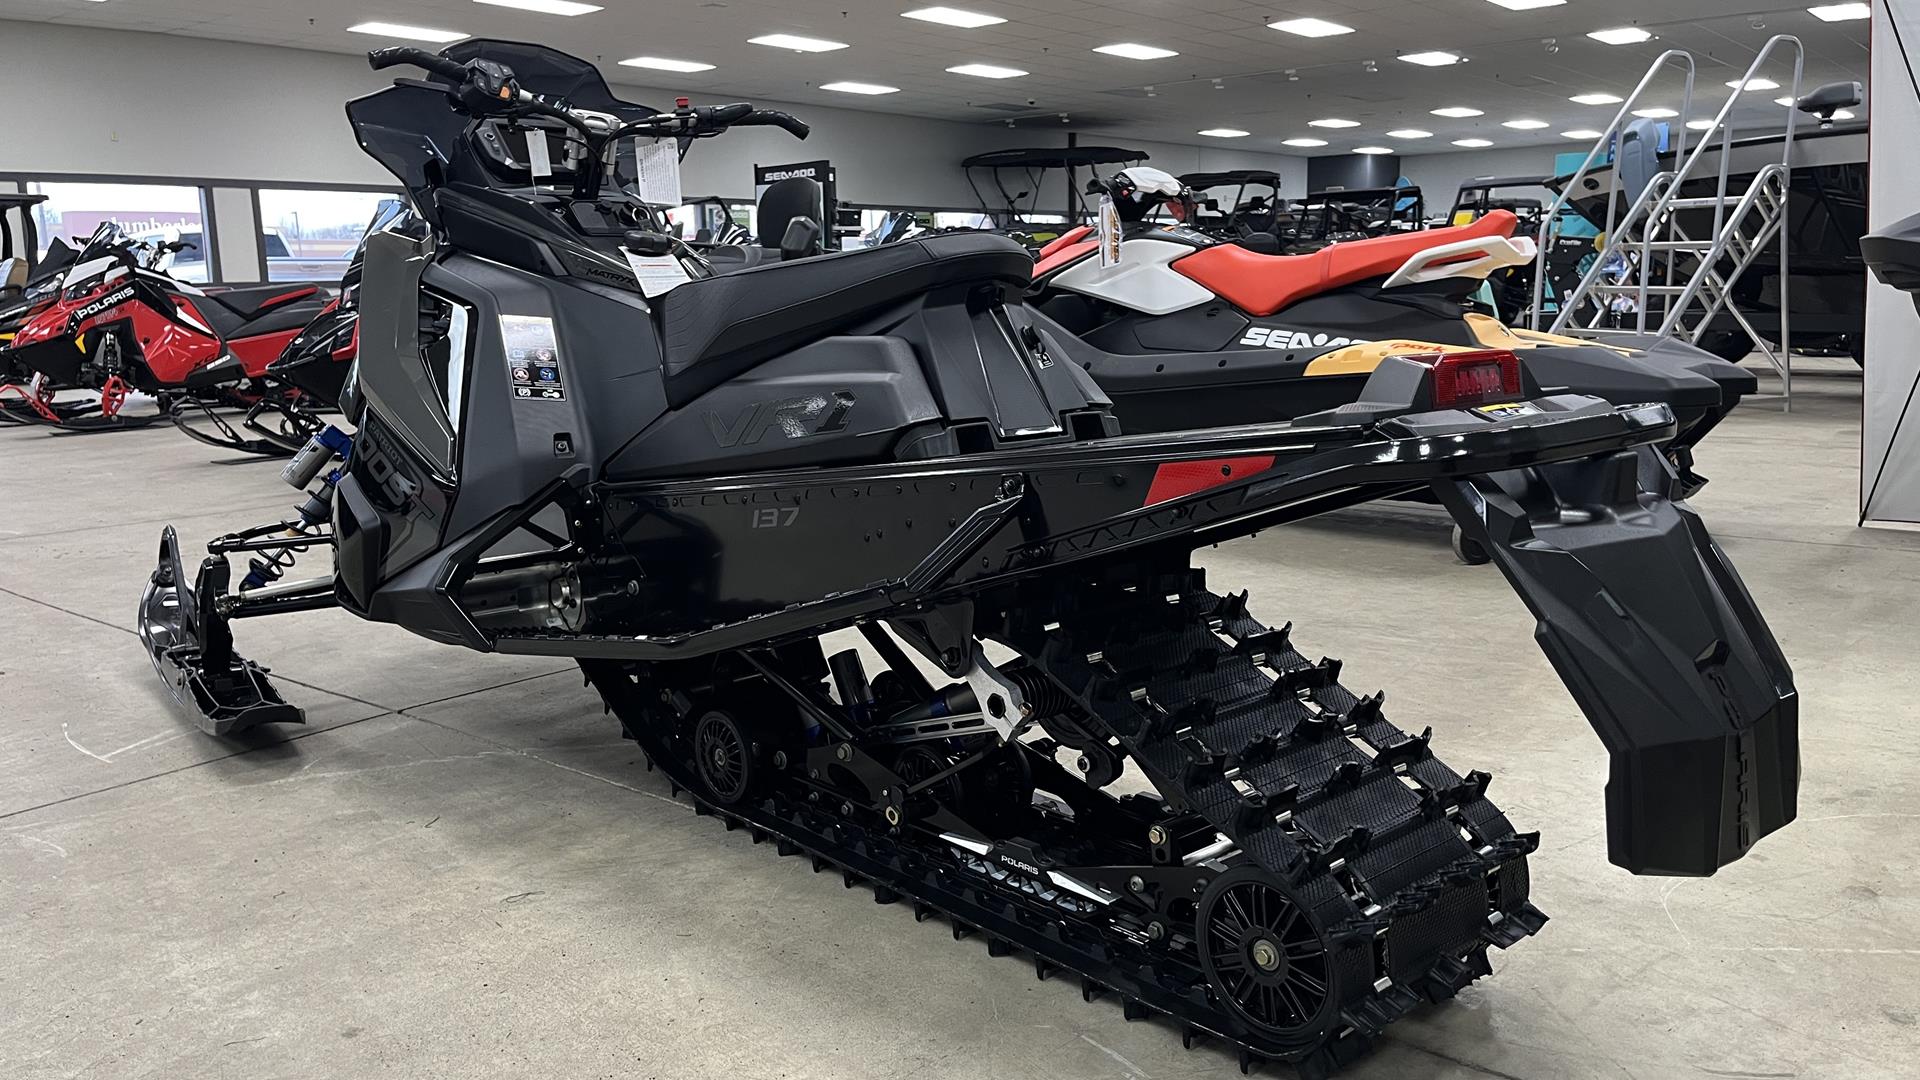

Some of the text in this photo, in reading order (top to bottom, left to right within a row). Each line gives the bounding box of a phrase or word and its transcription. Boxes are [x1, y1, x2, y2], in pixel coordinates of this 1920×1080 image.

[77, 286, 135, 320] POLARIS
[1388, 343, 1446, 352] park
[368, 420, 403, 466] PATRIOT
[357, 431, 435, 521] OOST
[752, 507, 800, 528] 137
[1001, 854, 1039, 875] POLARIS
